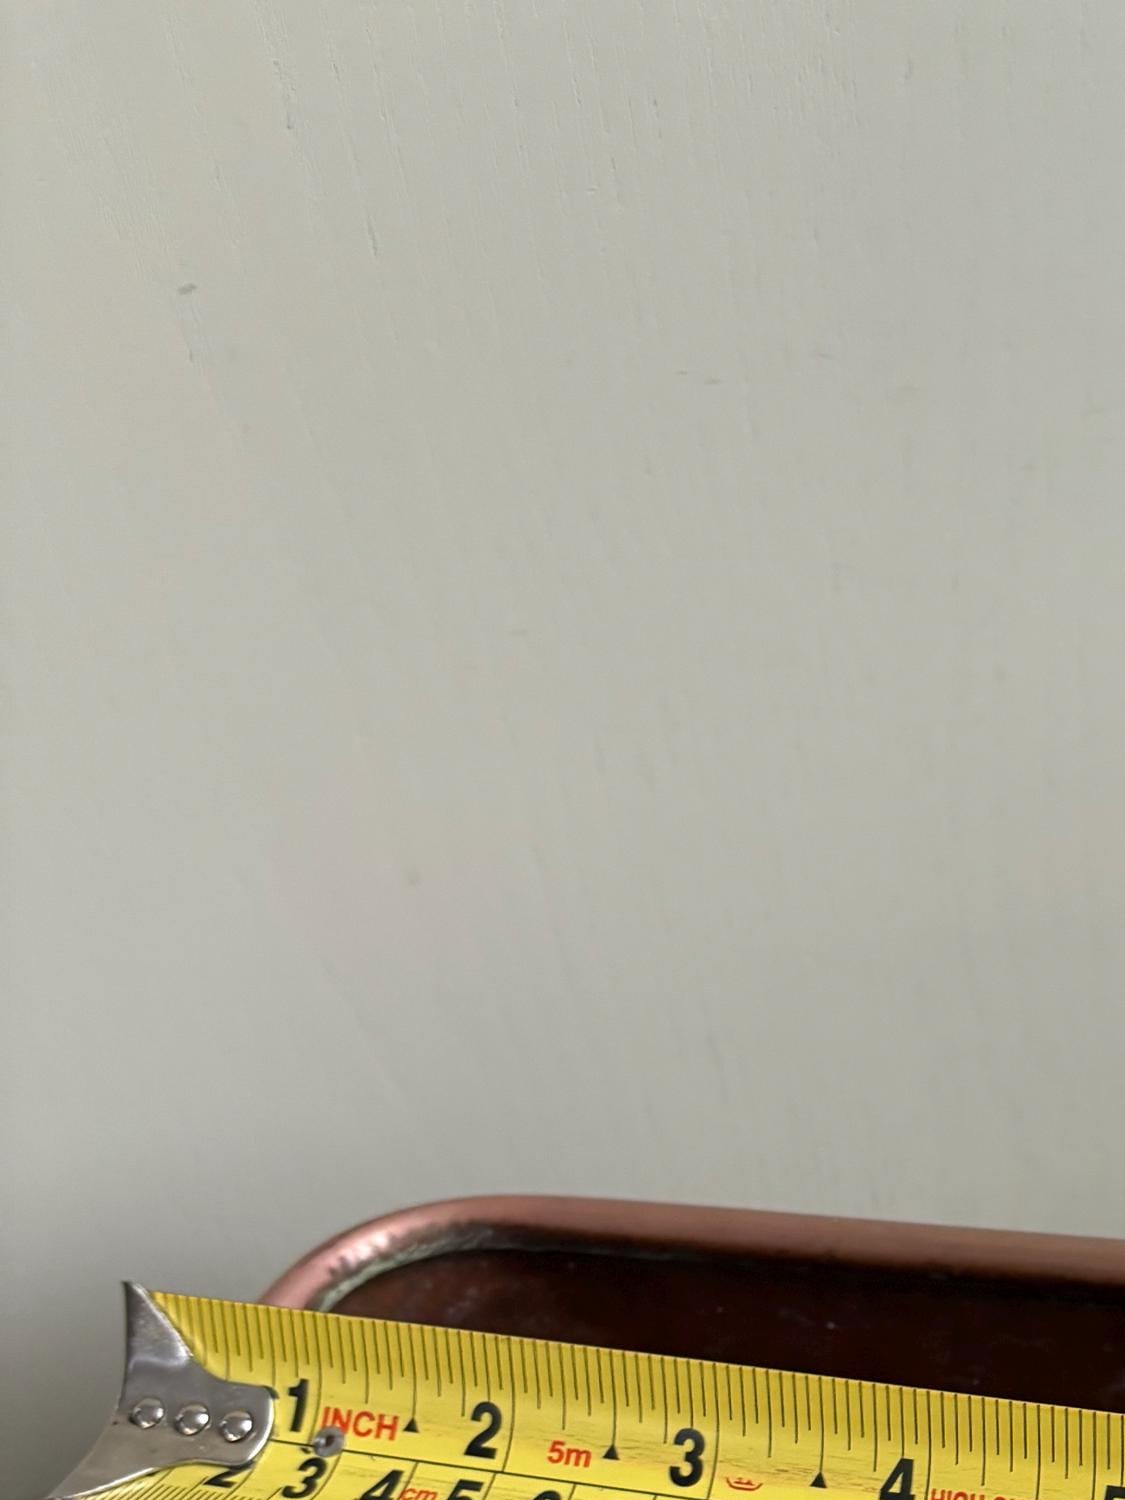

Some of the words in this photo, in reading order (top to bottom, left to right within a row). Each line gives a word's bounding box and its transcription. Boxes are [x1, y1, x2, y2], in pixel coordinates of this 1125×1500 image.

[289, 1378, 309, 1432] 1
[464, 1401, 502, 1459] 2
[669, 1428, 705, 1487] 3
[320, 1406, 399, 1441] INCH
[547, 1440, 591, 1468] 5m
[282, 1458, 327, 1499] 3
